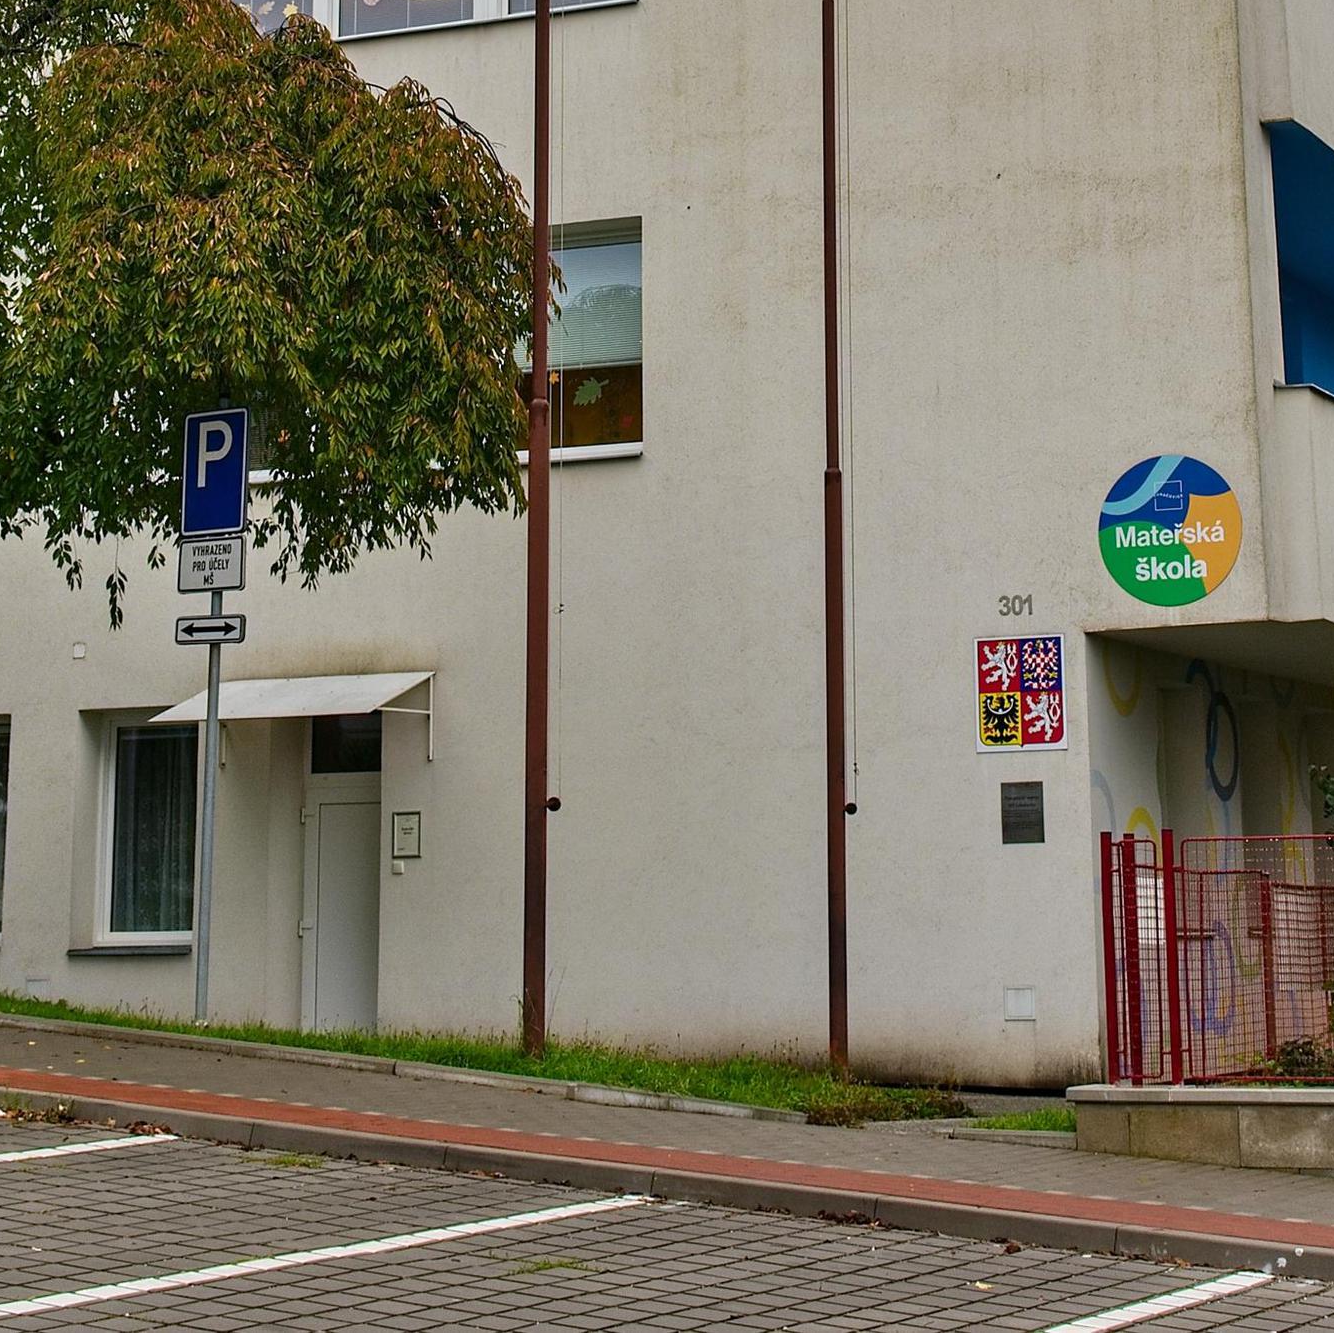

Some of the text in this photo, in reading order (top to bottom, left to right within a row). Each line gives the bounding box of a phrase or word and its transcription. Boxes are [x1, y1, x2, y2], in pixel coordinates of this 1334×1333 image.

[196, 419, 234, 488] P
[1114, 520, 1225, 548] Mateřská
[191, 543, 232, 557] VYHRAZENO
[192, 557, 230, 572] PRO ÚČELY
[1135, 554, 1208, 582] škola
[203, 572, 214, 586] MŠ
[998, 594, 1033, 616] 301
